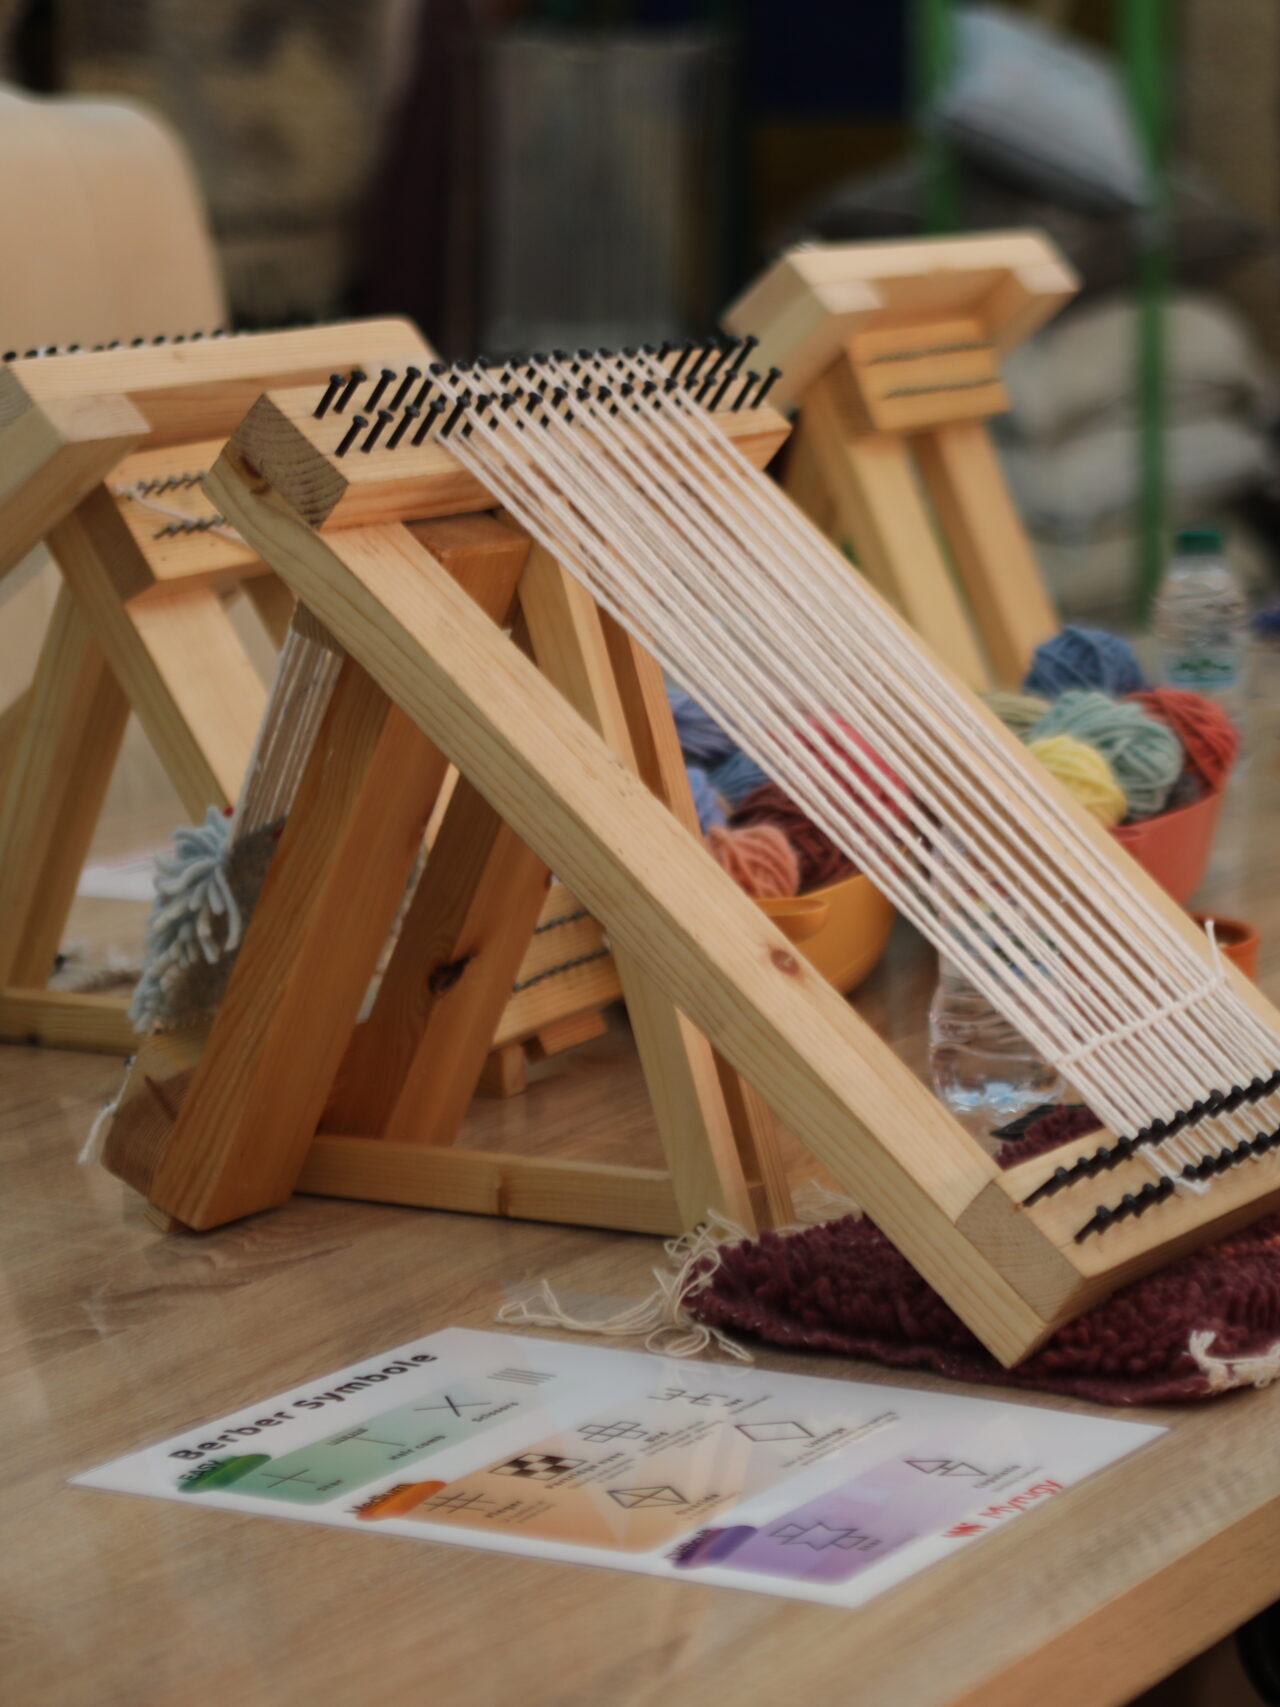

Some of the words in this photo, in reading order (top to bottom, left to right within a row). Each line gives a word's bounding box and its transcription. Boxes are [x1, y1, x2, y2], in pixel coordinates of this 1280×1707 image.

[168, 1411, 297, 1460] Berber
[291, 1354, 438, 1410] Symbole
[177, 1458, 224, 1481] EASY
[348, 1483, 411, 1513] Medium
[978, 1479, 1065, 1518] Myrugy
